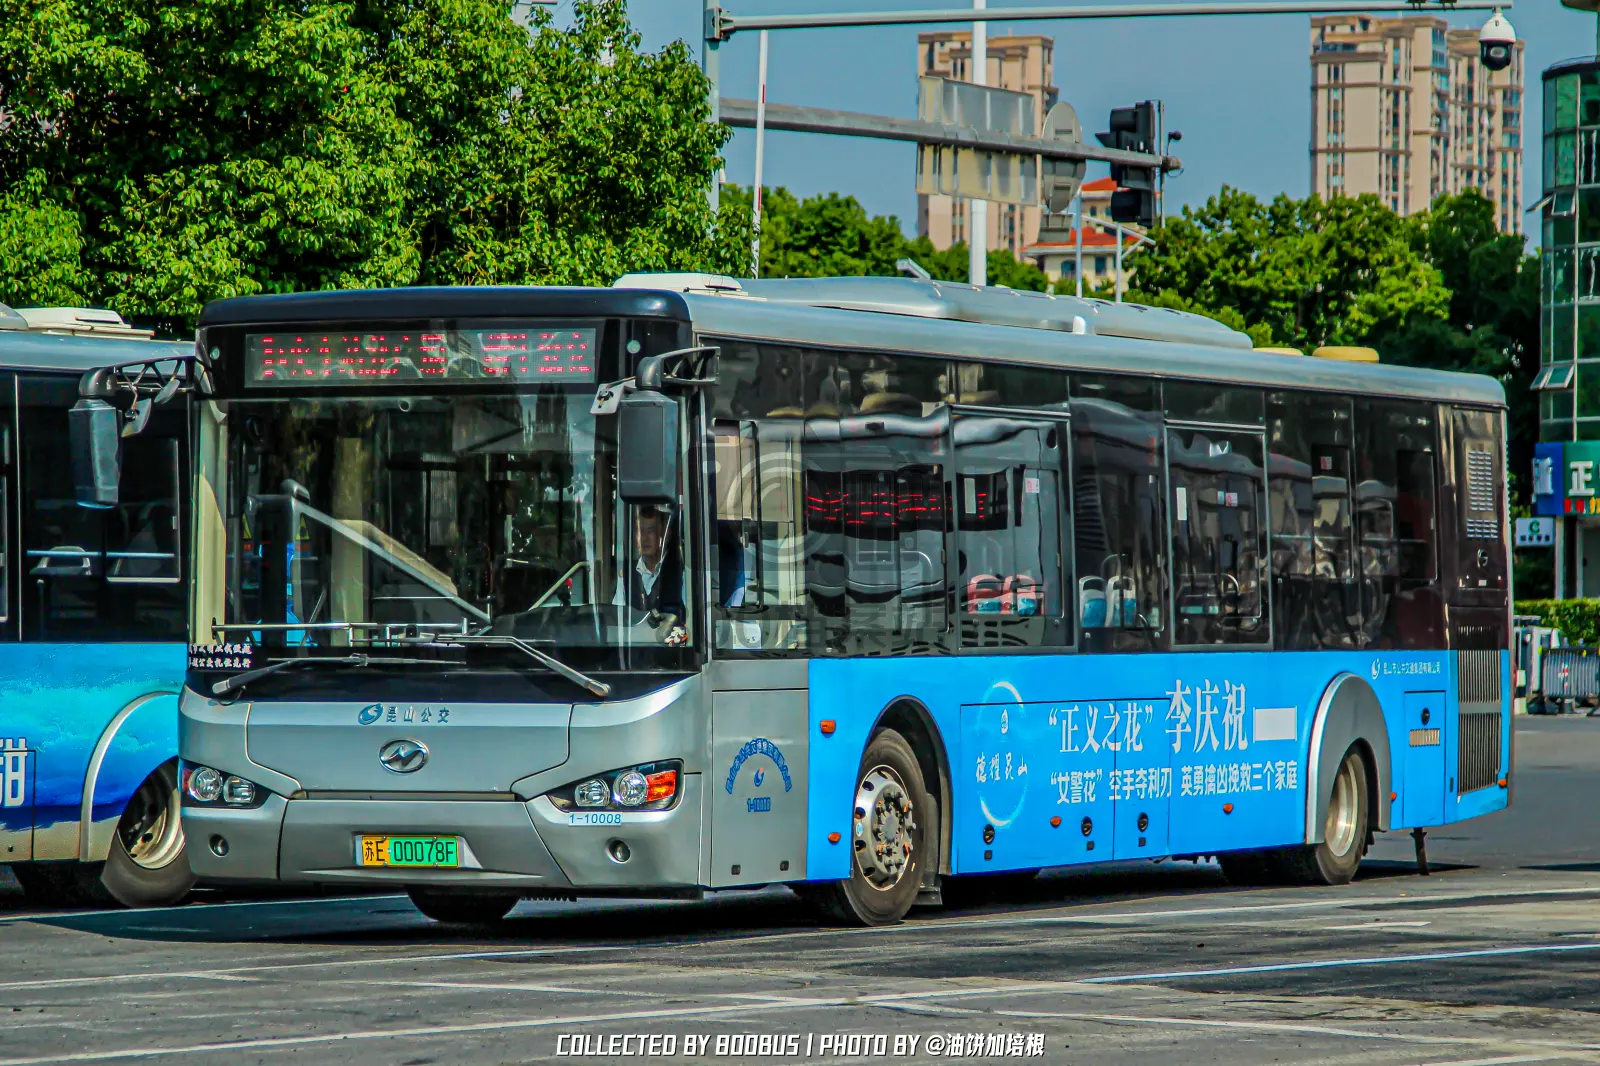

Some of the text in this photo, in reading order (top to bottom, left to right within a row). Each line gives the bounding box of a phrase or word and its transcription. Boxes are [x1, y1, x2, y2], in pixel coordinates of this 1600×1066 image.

[386, 701, 450, 723] 昆山公交
[1165, 679, 1249, 753] 李庆祝
[1109, 767, 1173, 801] 空手夺利刃
[1181, 759, 1298, 797] 英勇擒凶挽救三个家庭
[569, 813, 621, 824] 1-10008
